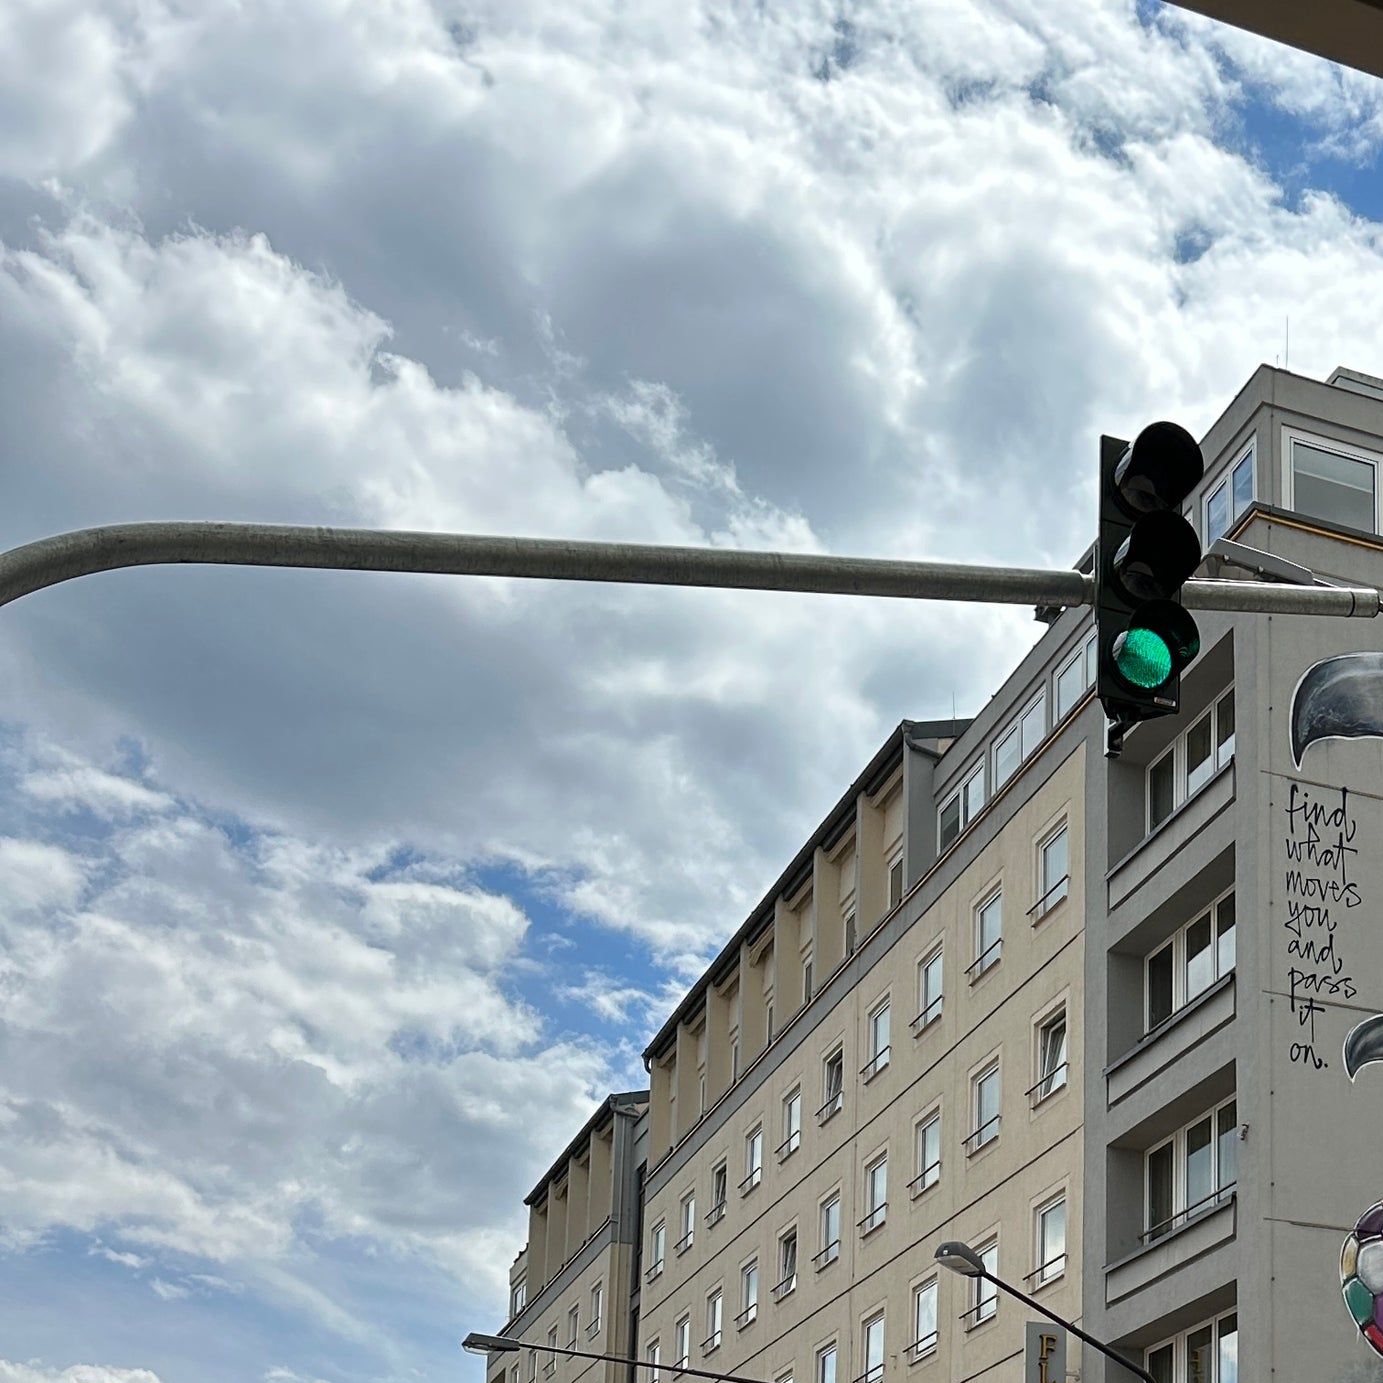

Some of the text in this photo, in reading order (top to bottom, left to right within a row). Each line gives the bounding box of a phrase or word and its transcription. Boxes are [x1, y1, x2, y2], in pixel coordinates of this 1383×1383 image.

[1285, 784, 1356, 841] find
[1286, 822, 1358, 884] what
[1286, 870, 1362, 907] moves
[1284, 901, 1337, 938] you
[1287, 934, 1342, 974] and
[1287, 967, 1357, 1012] pass
[1299, 998, 1326, 1043] it
